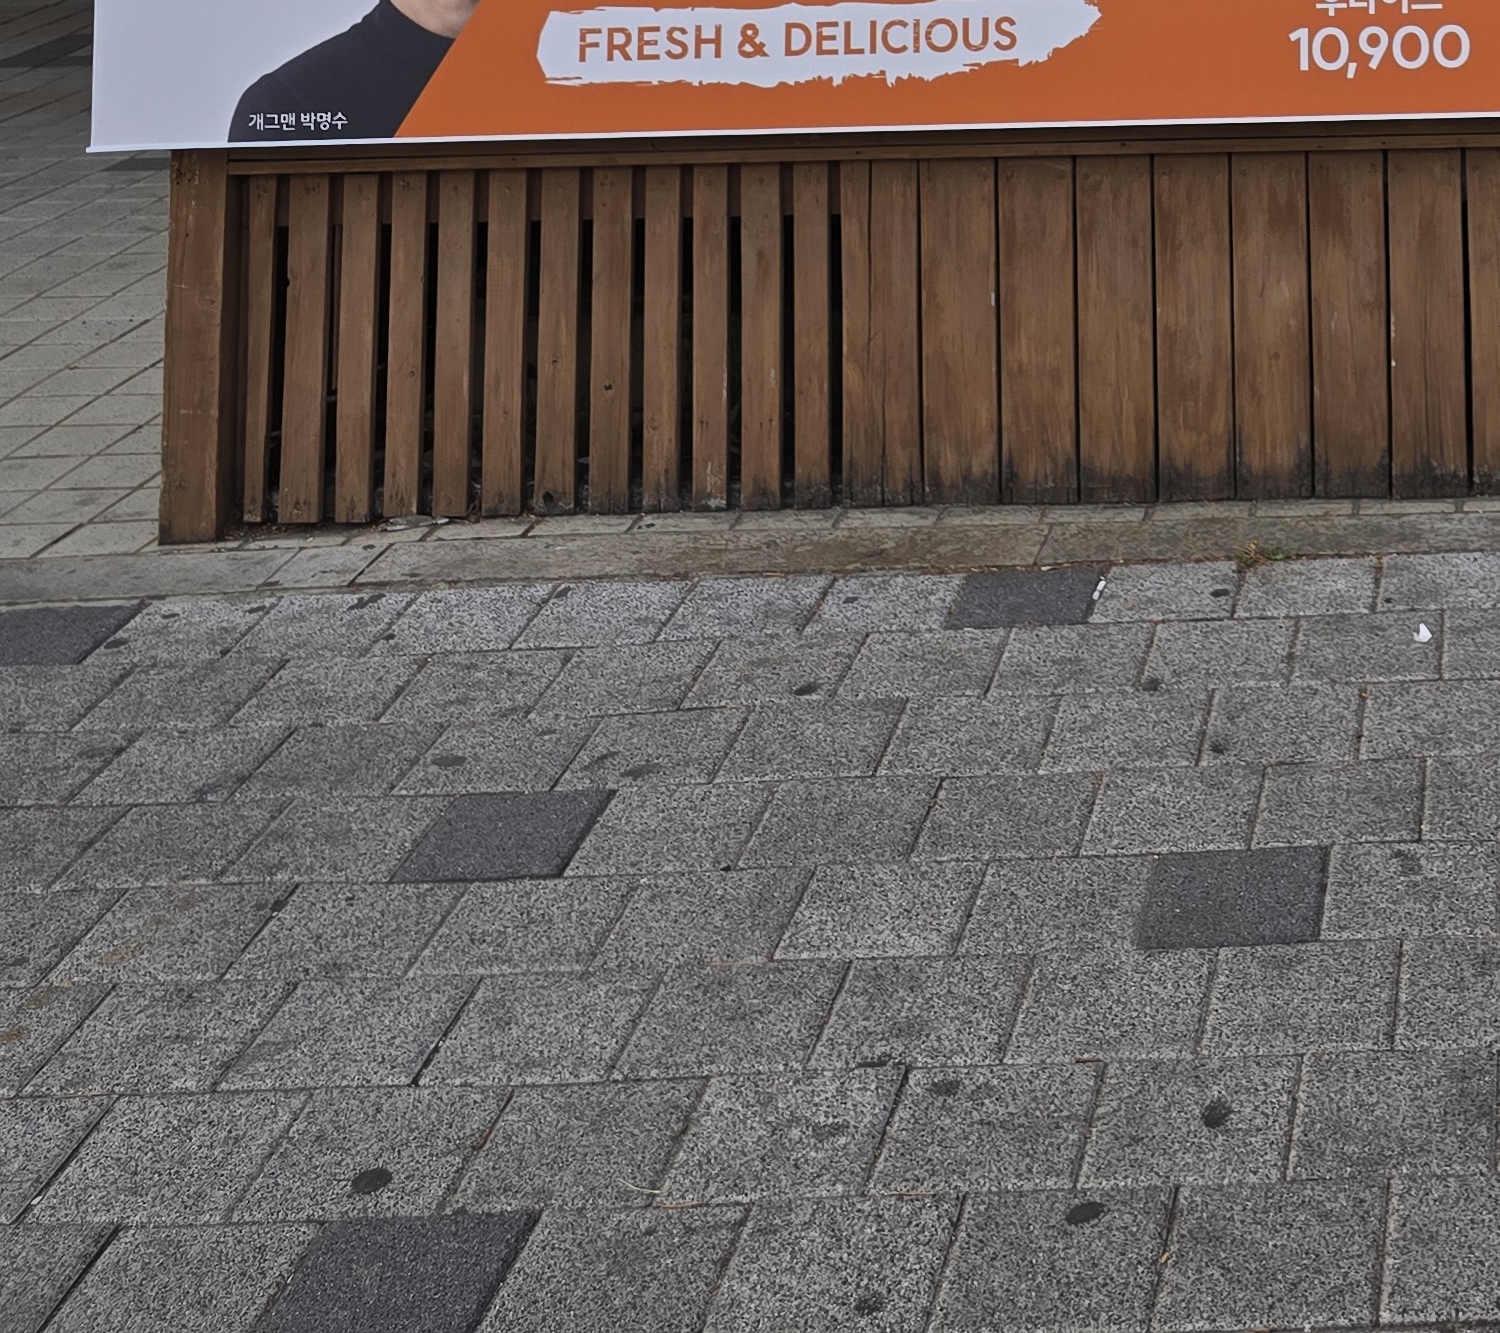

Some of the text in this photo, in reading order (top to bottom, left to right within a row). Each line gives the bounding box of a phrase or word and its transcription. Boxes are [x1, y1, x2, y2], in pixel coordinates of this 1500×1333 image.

[578, 16, 1017, 63] FRESH & DELICIOUS
[1288, 23, 1471, 79] 10,900
[248, 110, 348, 131] 개그맨 박명수
